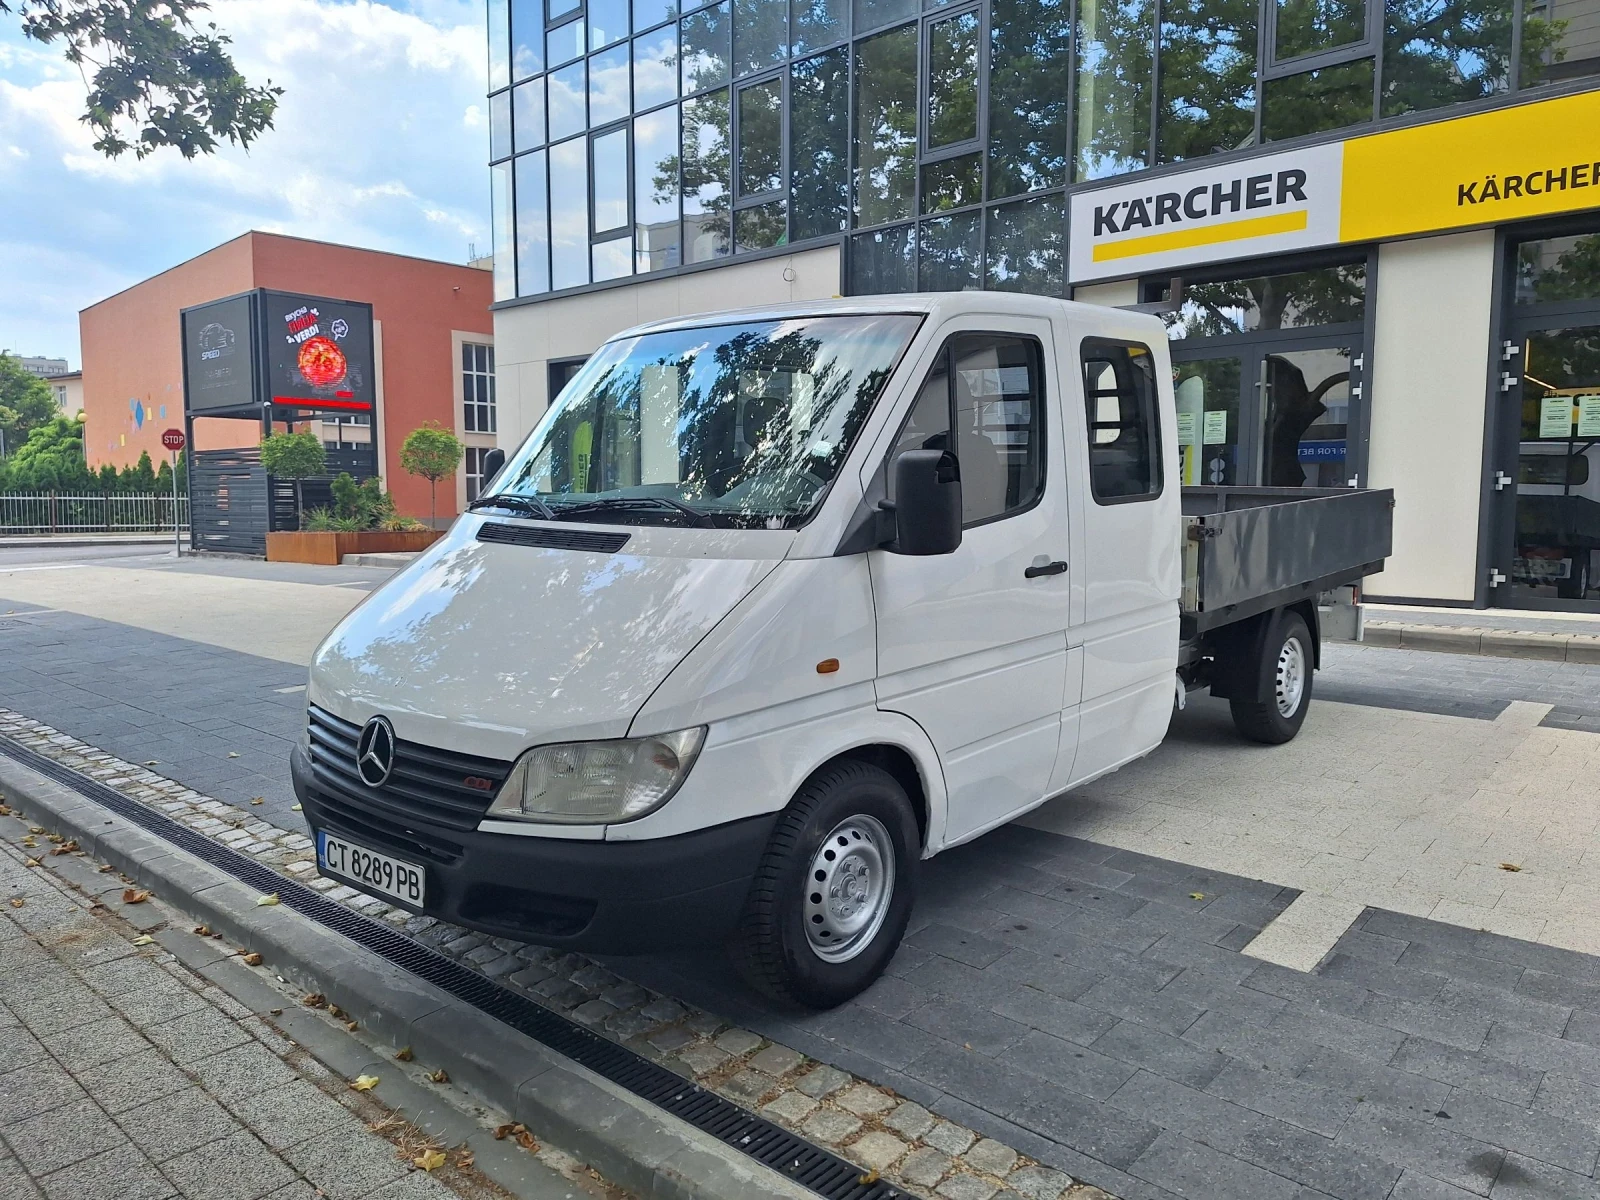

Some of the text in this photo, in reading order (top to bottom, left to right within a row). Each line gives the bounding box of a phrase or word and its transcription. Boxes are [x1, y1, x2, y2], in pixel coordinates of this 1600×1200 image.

[1093, 168, 1308, 237] KÄRCHER
[294, 323, 320, 344] VERDI
[163, 435, 184, 444] STOP
